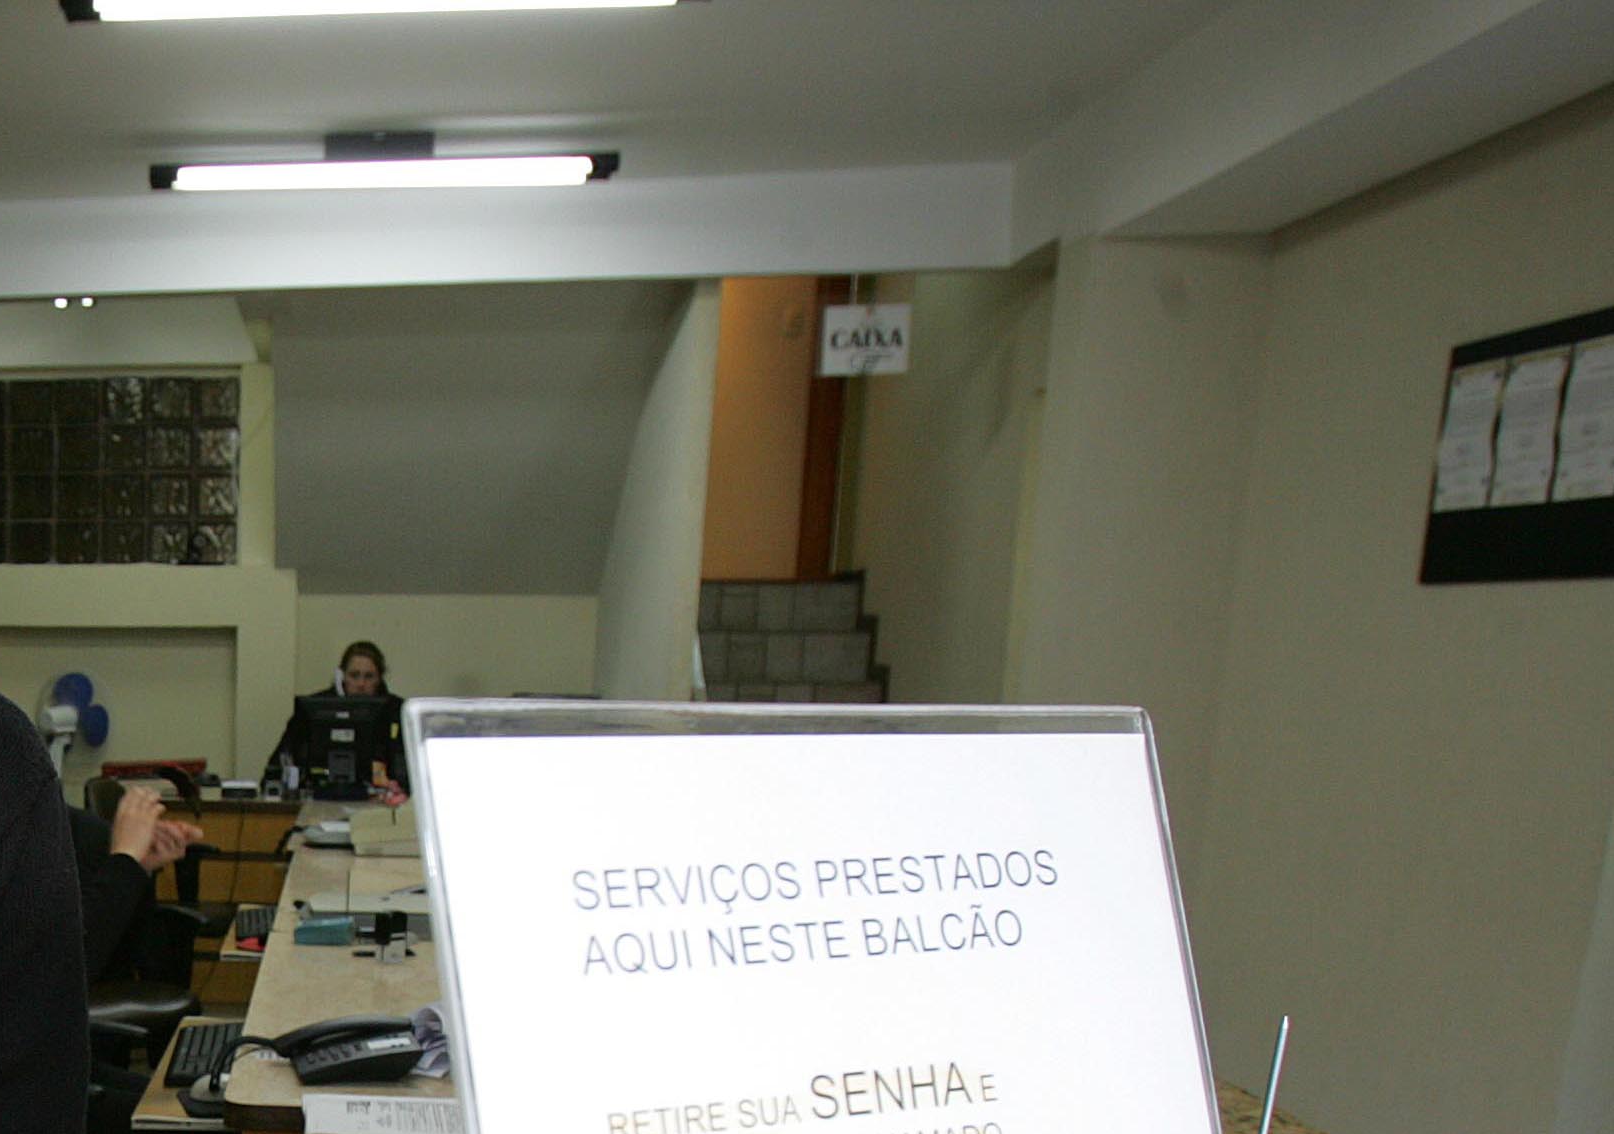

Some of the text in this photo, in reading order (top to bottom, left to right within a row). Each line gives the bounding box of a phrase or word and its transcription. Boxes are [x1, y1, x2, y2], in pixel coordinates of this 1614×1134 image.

[831, 326, 902, 349] CAIXA
[573, 850, 1059, 915] SERVIÇOS PRESTADOS
[584, 904, 1023, 975] AQUI NESTE BALCÃO
[738, 1095, 802, 1128] SUA
[810, 1062, 973, 1120] SENHA
[980, 1074, 998, 1102] E
